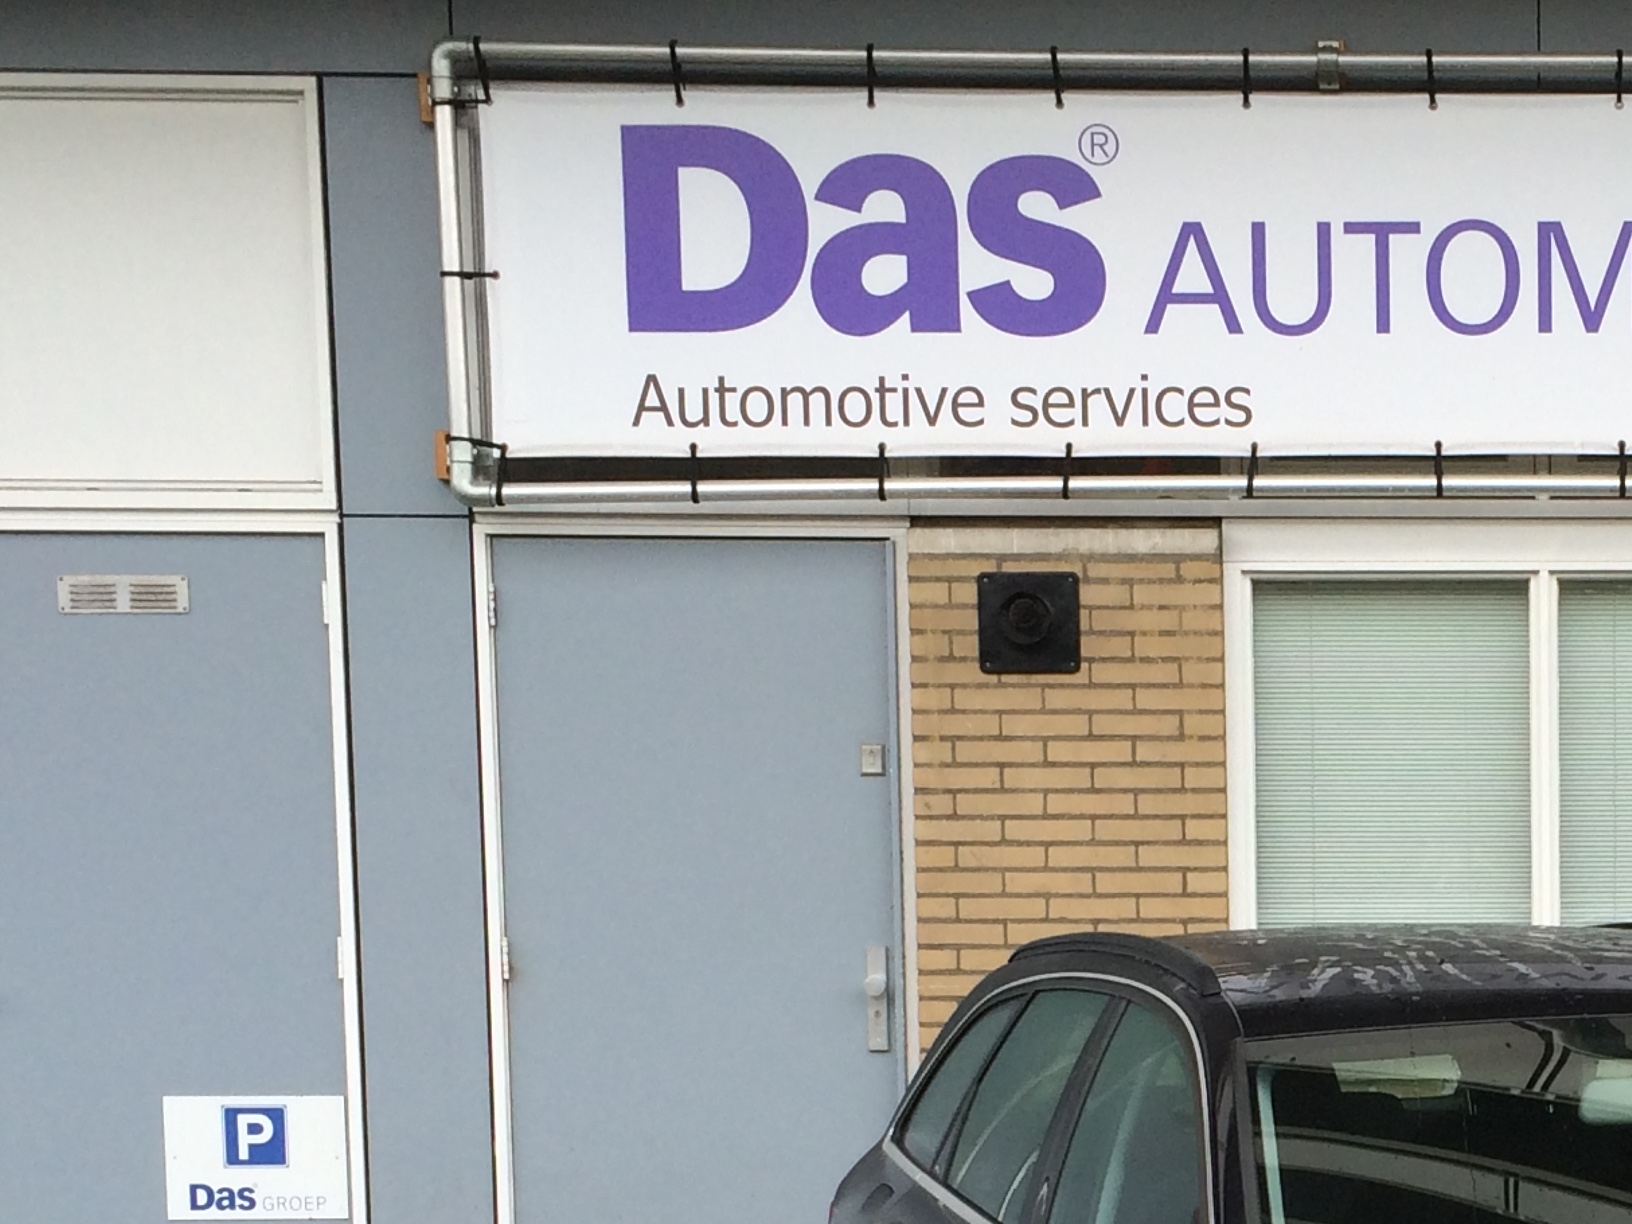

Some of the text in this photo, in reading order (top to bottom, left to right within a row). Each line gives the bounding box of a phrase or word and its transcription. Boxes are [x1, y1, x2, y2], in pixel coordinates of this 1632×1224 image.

[631, 372, 1254, 429] Automotive services
[236, 1112, 274, 1161] P
[188, 1183, 327, 1212] Das GROEP
